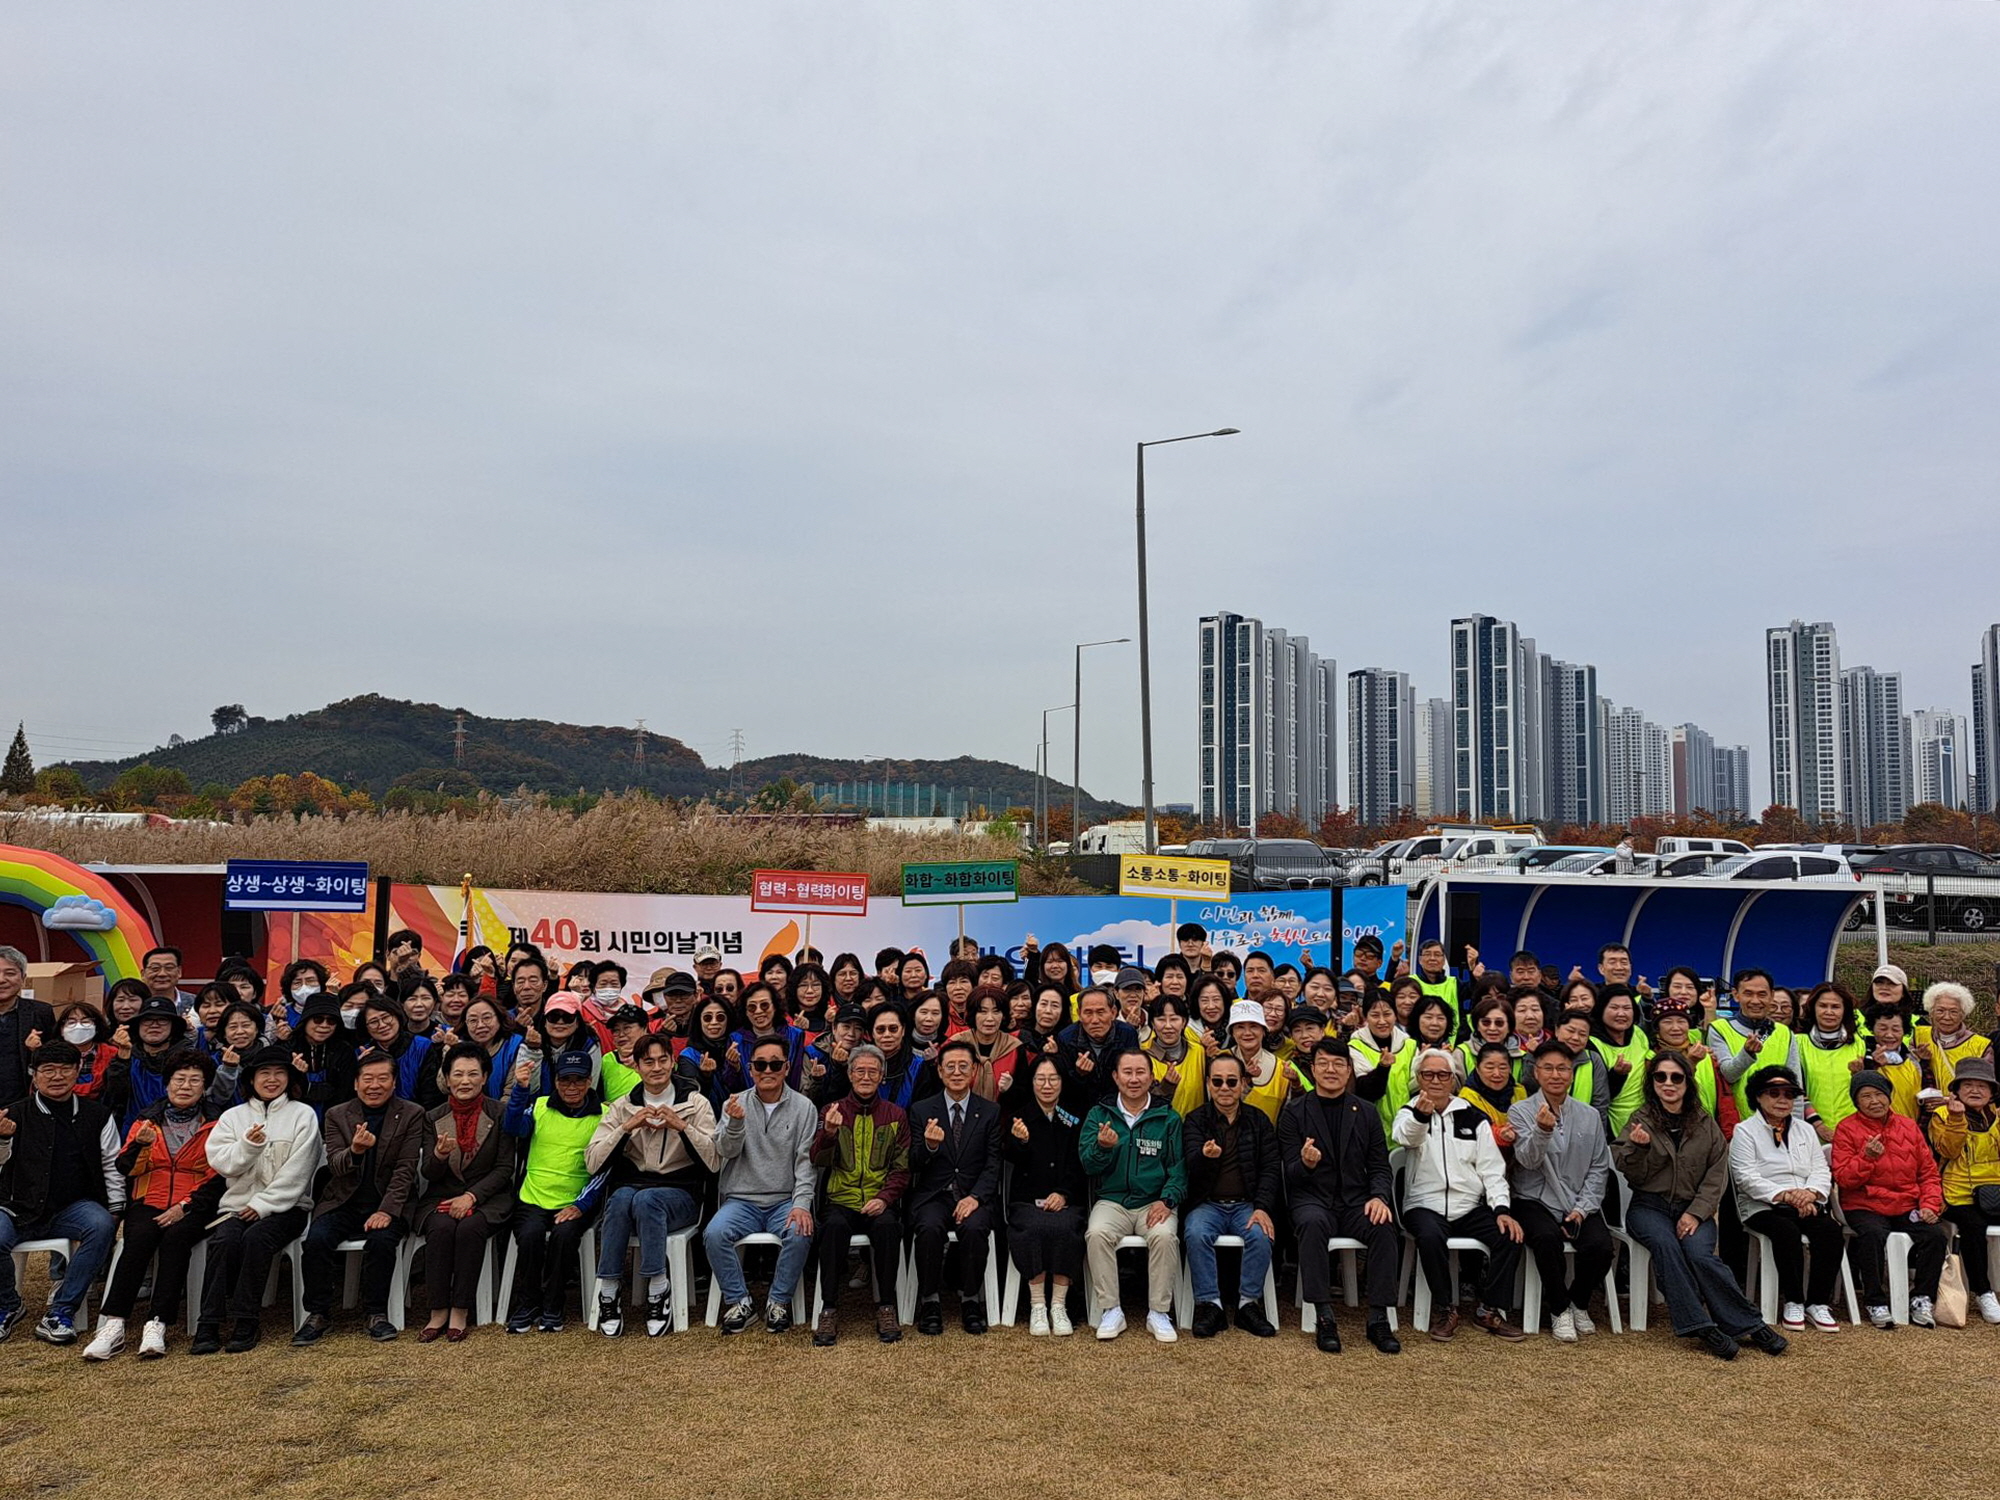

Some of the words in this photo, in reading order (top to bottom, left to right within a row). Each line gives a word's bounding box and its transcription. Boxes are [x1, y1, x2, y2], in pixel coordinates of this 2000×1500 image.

[226, 874, 366, 896] 상생~상생~화이팅
[904, 869, 1015, 888] 화합~화합화이팅
[1126, 865, 1227, 887] 소통소통~화이팅
[759, 880, 864, 901] 협력~협력화이팅
[1200, 905, 1254, 924] 시민과
[508, 918, 601, 953] 제40회
[607, 930, 743, 954] 시민의날기념
